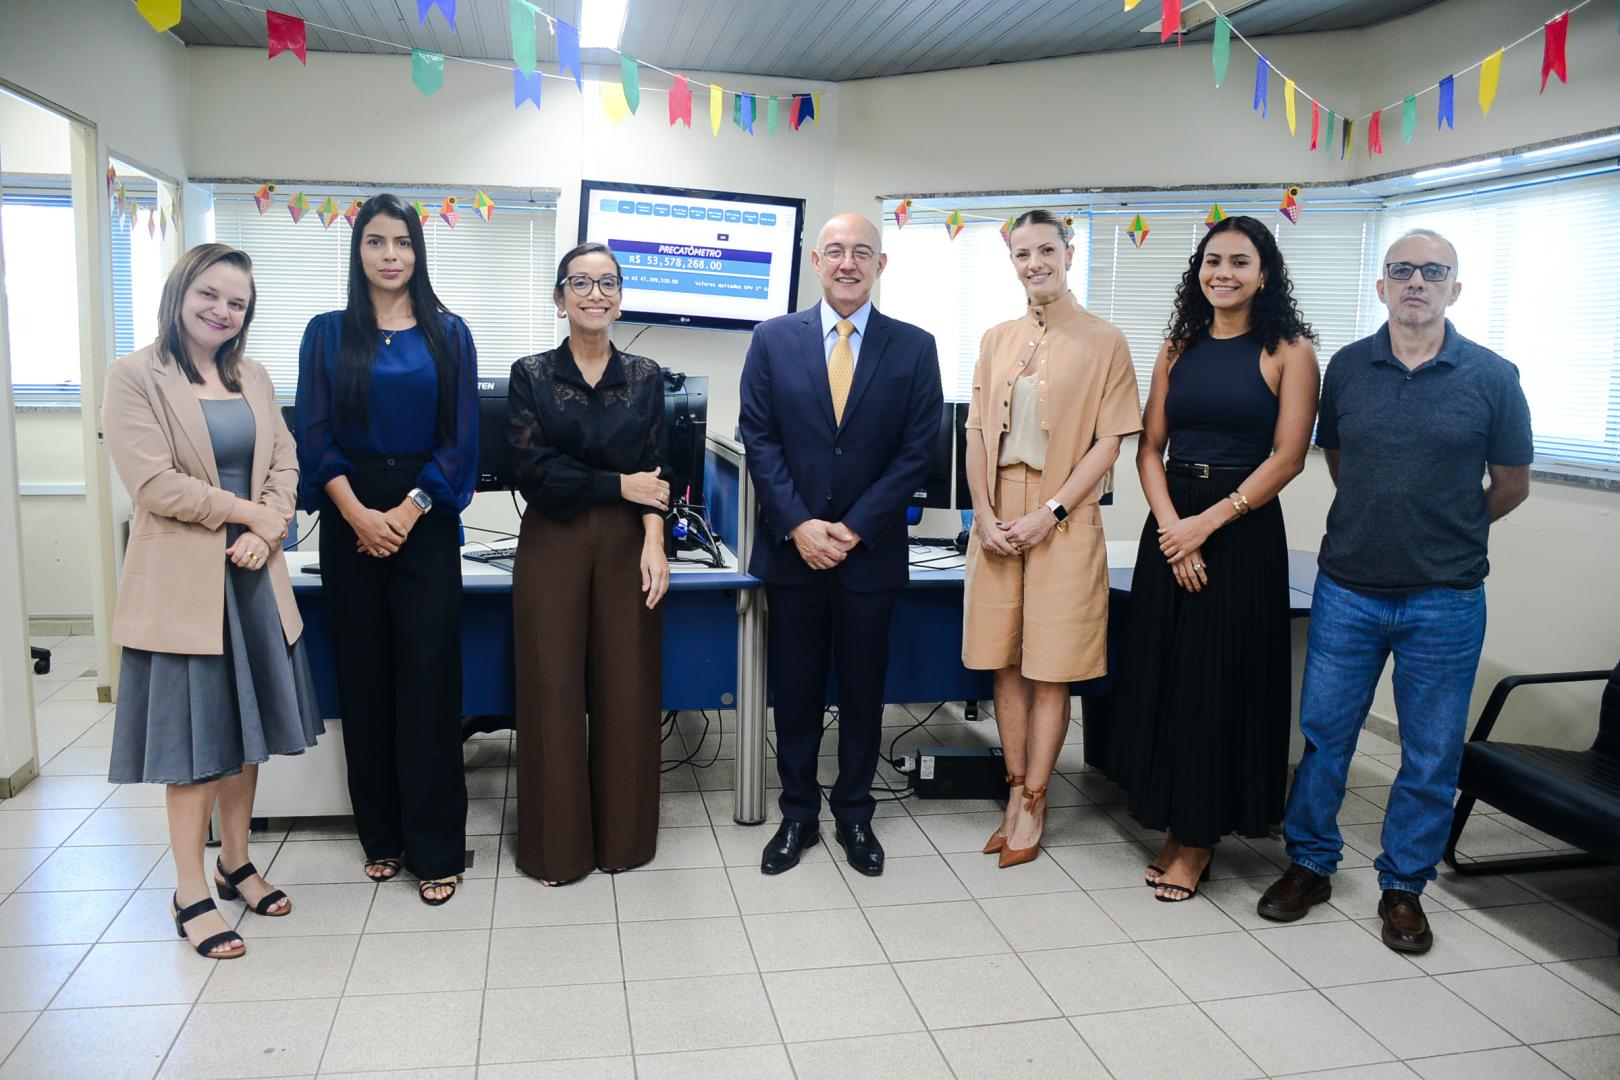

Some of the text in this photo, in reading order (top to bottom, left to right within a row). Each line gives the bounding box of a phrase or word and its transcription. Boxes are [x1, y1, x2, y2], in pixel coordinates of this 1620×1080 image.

[659, 245, 722, 258] PRECATÔMETRO
[629, 255, 722, 271] R$ 53,578,268.00
[477, 382, 495, 390] TEN
